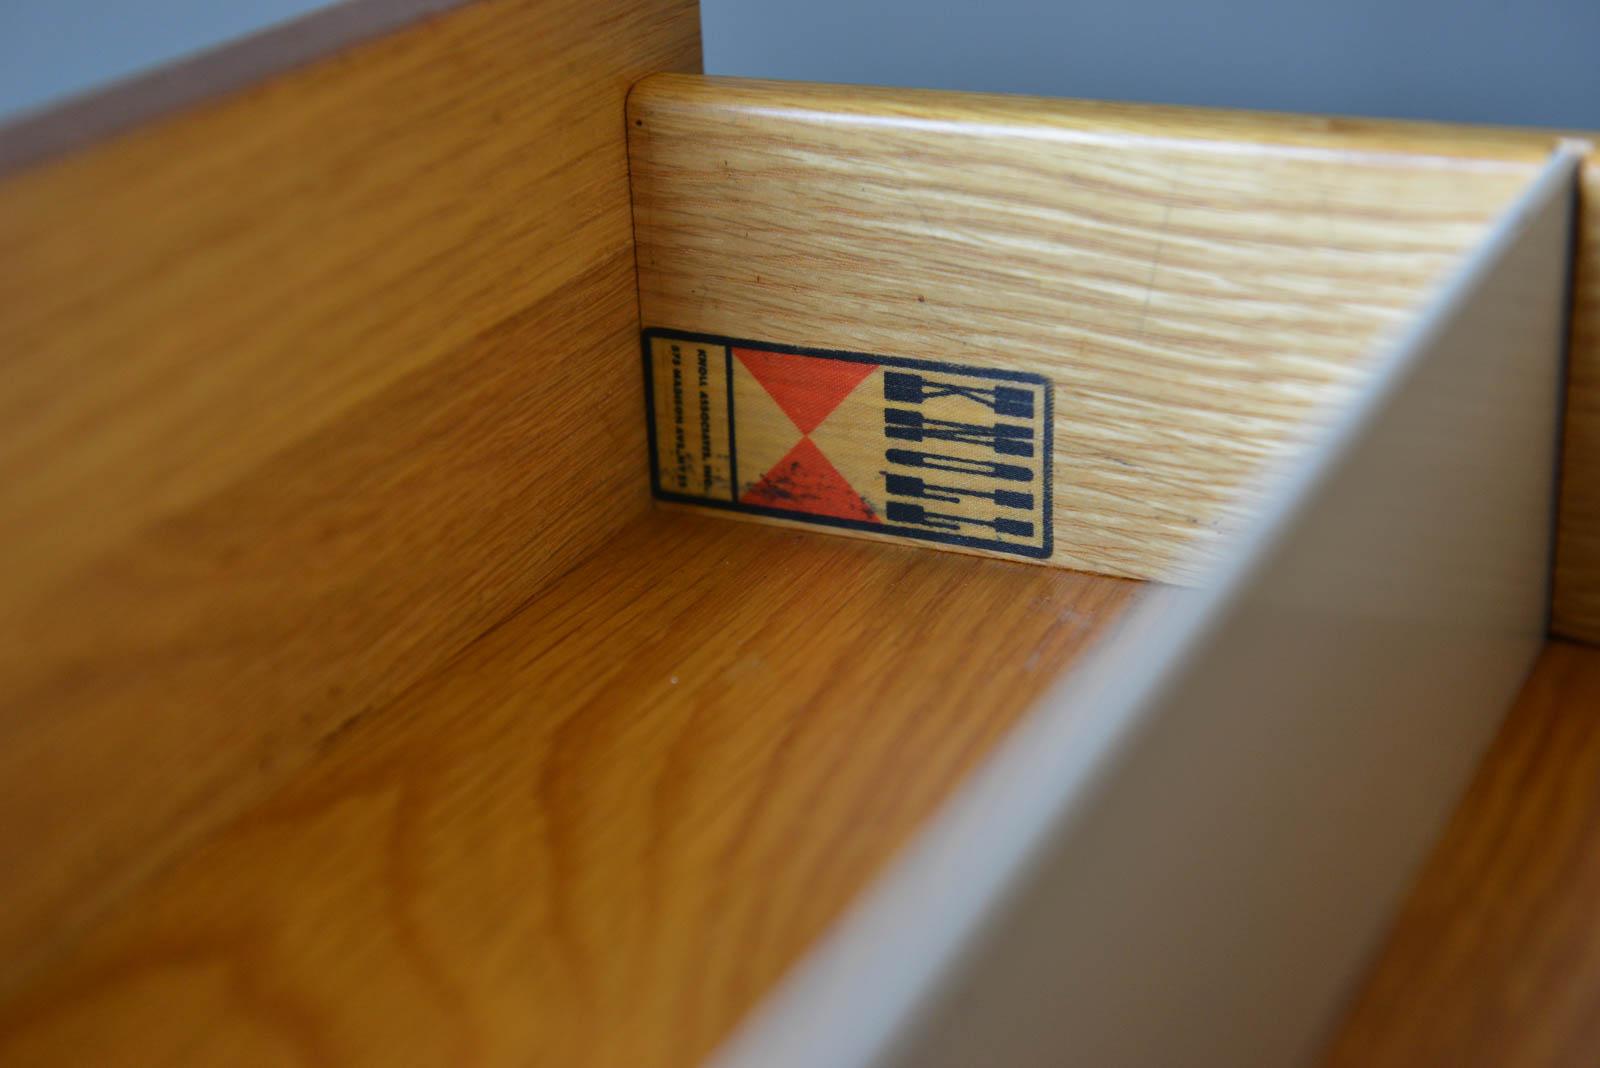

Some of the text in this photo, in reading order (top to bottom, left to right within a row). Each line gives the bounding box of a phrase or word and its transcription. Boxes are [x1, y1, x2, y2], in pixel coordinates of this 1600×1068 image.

[697, 349, 707, 386] KNOLL
[673, 369, 684, 424] MADISON
[884, 371, 1034, 537] KNOLL
